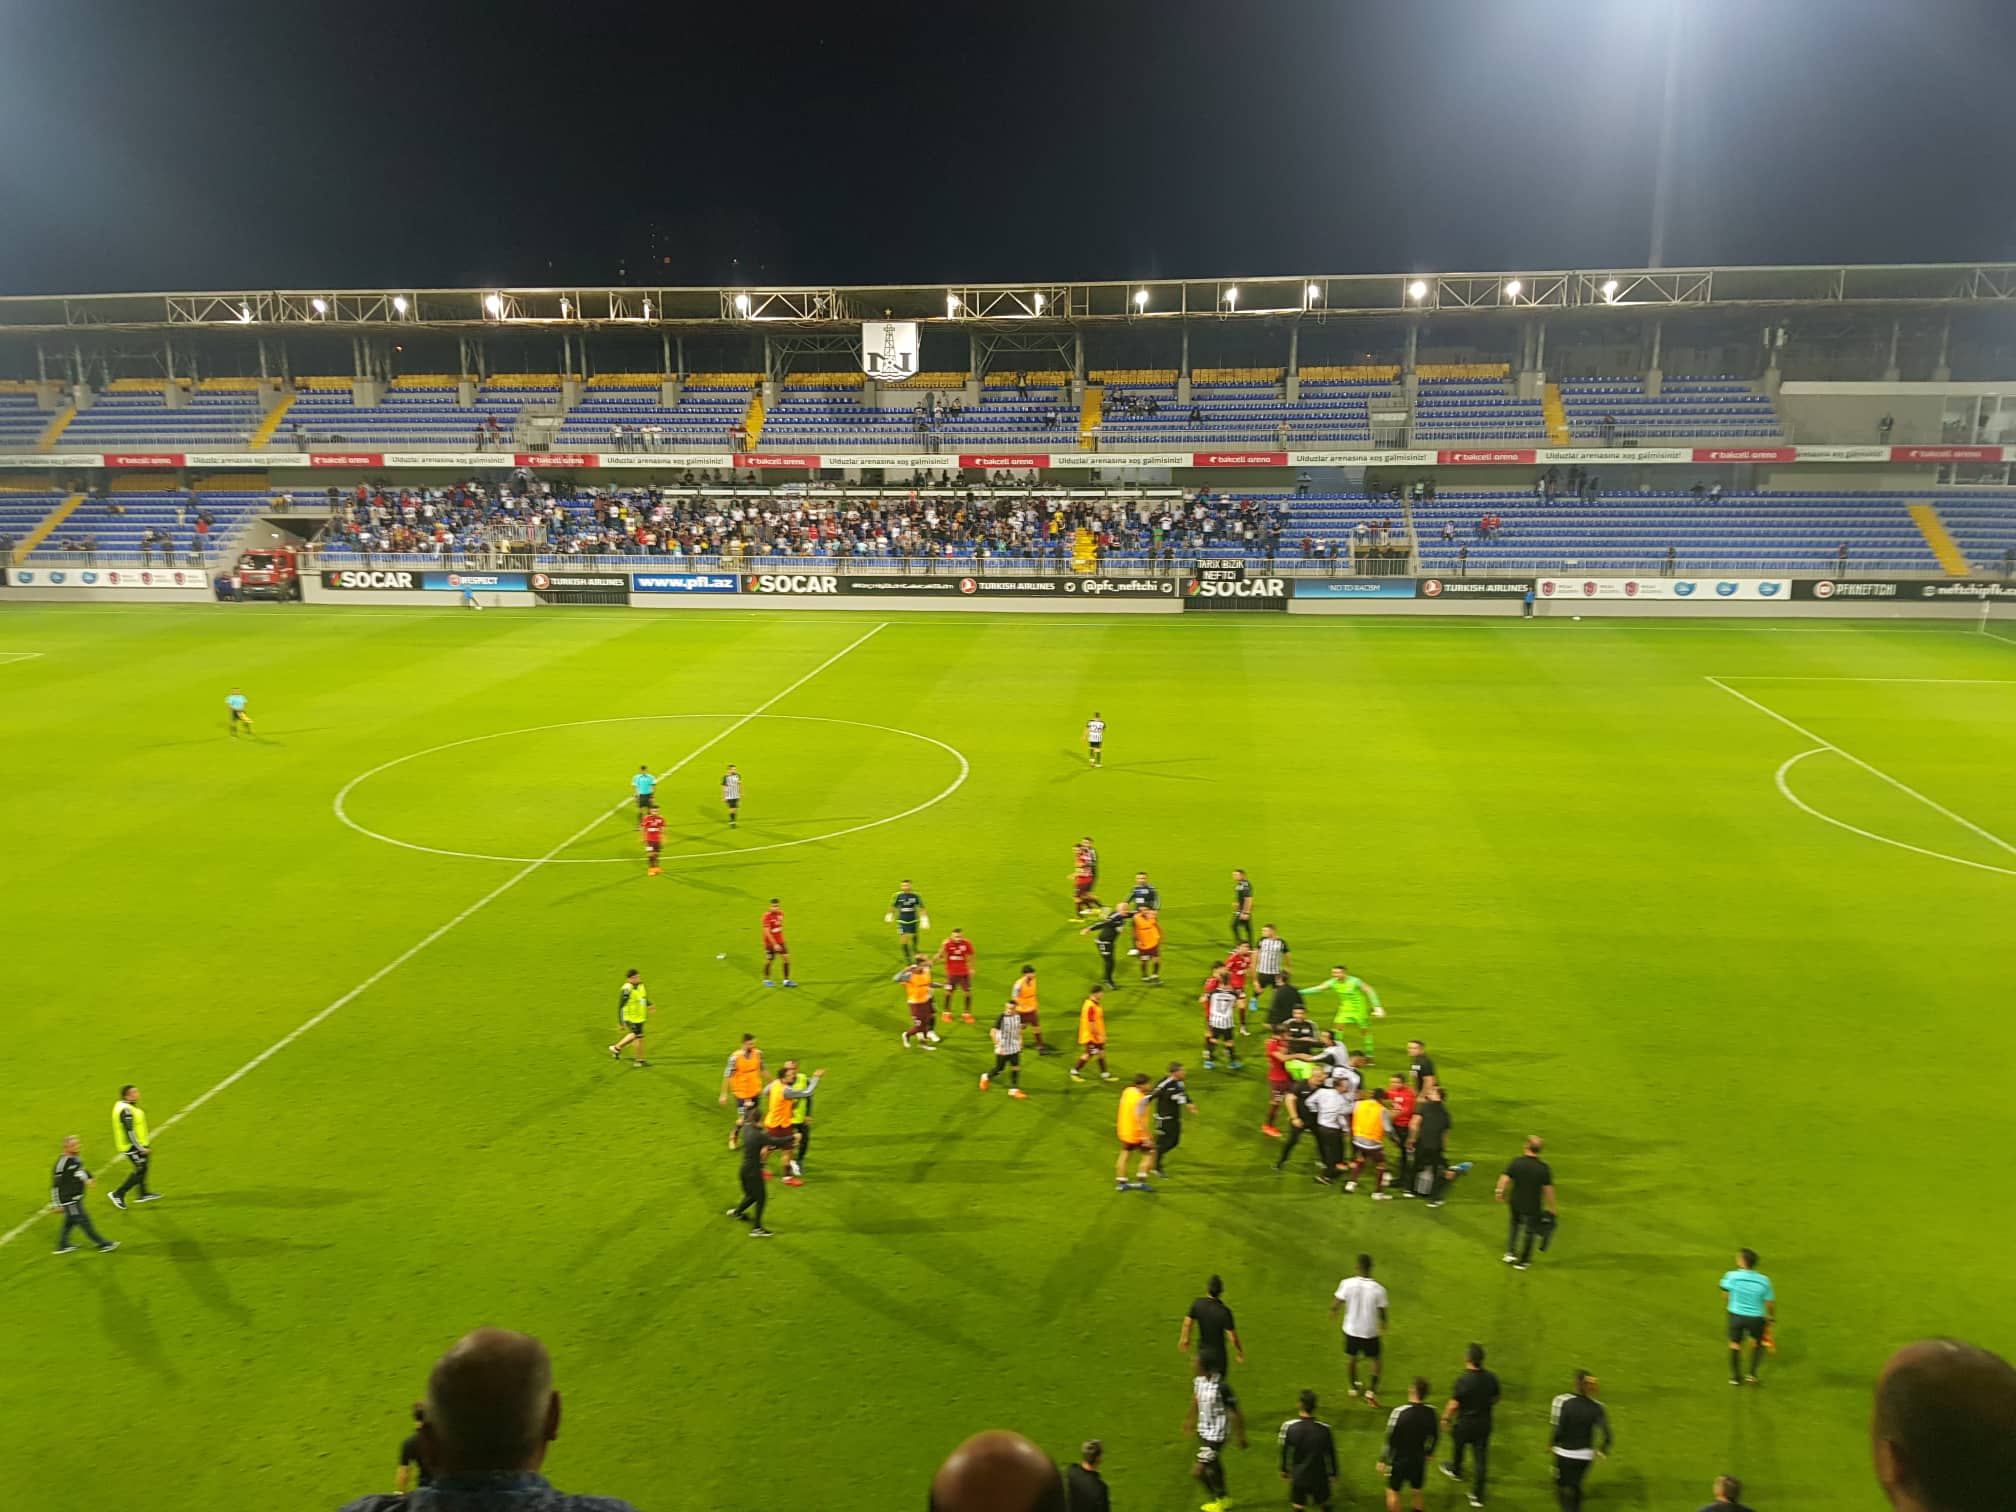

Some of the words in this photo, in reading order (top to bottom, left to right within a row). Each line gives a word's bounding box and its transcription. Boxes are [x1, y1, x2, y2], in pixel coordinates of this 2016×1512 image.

[342, 572, 413, 588] SOCAR
[460, 576, 498, 584] RESPECT
[550, 578, 586, 586] TURKISH
[588, 578, 624, 586] AIRLINES
[638, 576, 734, 590] www.pfl.az
[760, 576, 838, 593] SOCAR
[979, 582, 1016, 590] TURKISH
[1017, 582, 1056, 590] AIRLINES
[1082, 580, 1158, 593] @pfc_neftchi
[1200, 579, 1284, 597] SOCAR
[1444, 584, 1484, 592] TURKISH
[1486, 584, 1528, 592] AIRLINES
